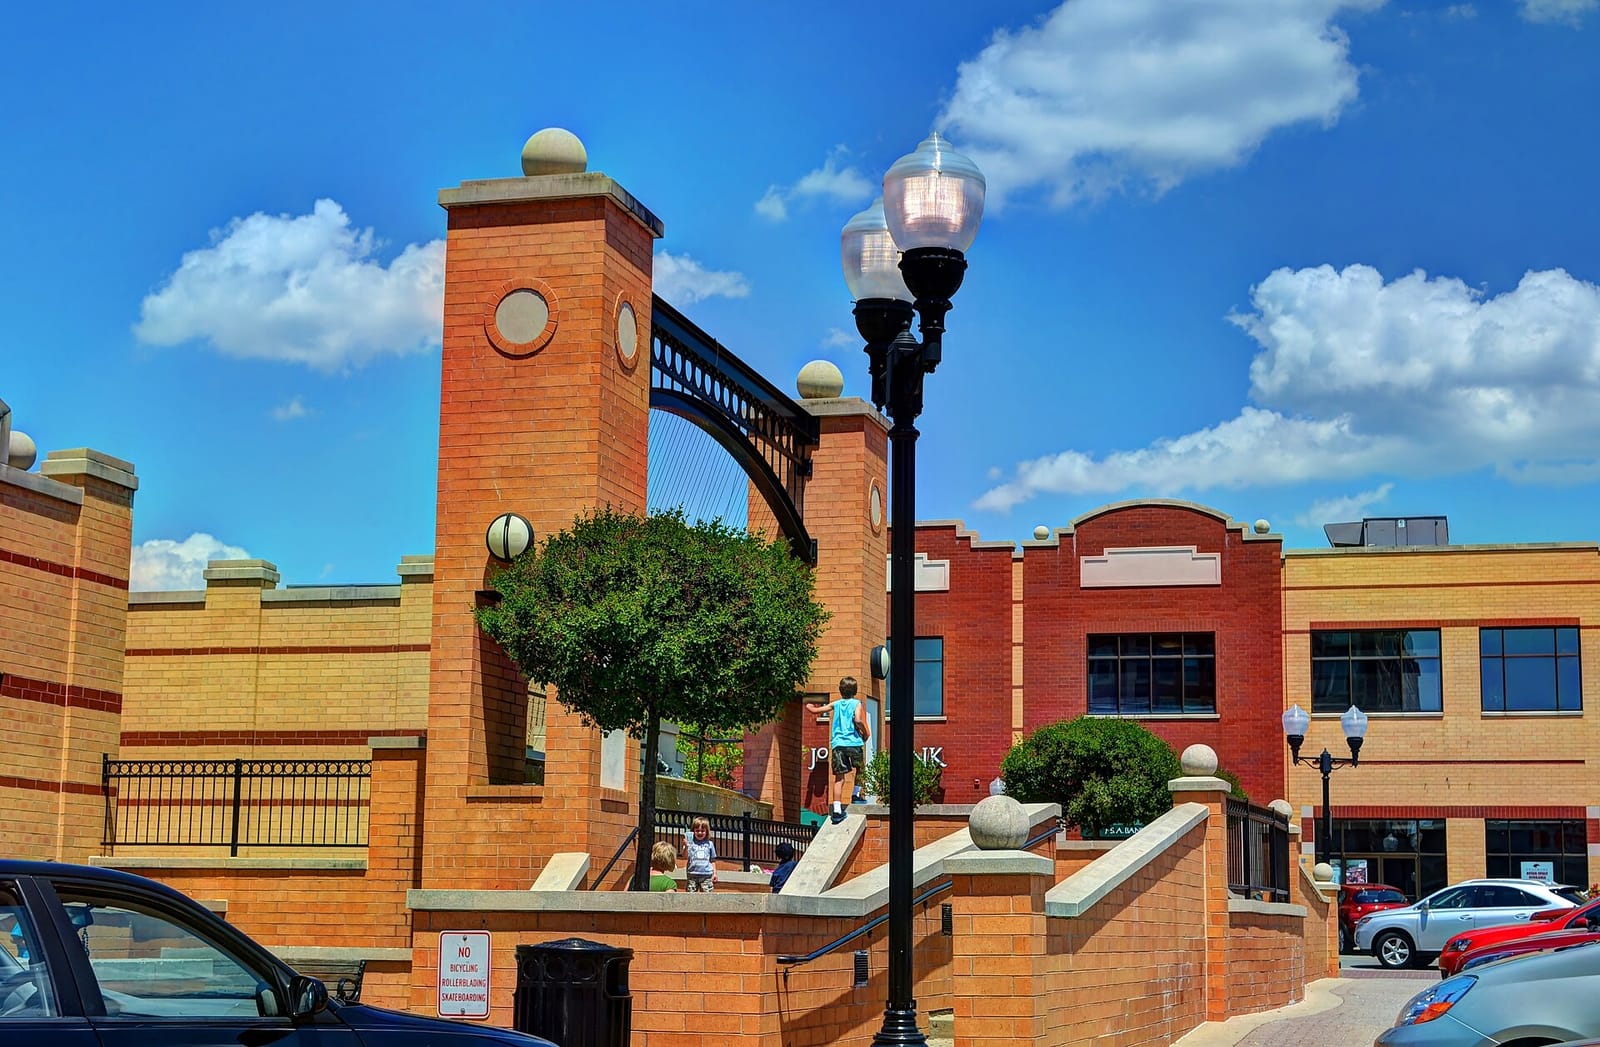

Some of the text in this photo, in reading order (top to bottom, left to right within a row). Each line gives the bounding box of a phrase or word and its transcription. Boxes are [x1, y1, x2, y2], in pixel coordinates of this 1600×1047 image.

[808, 747, 948, 770] JO NK
[458, 947, 471, 958] NO
[450, 964, 479, 973] BICYCLING
[441, 978, 487, 988] ROLLERBLADING
[441, 992, 486, 1002] SKATEBOARDING
